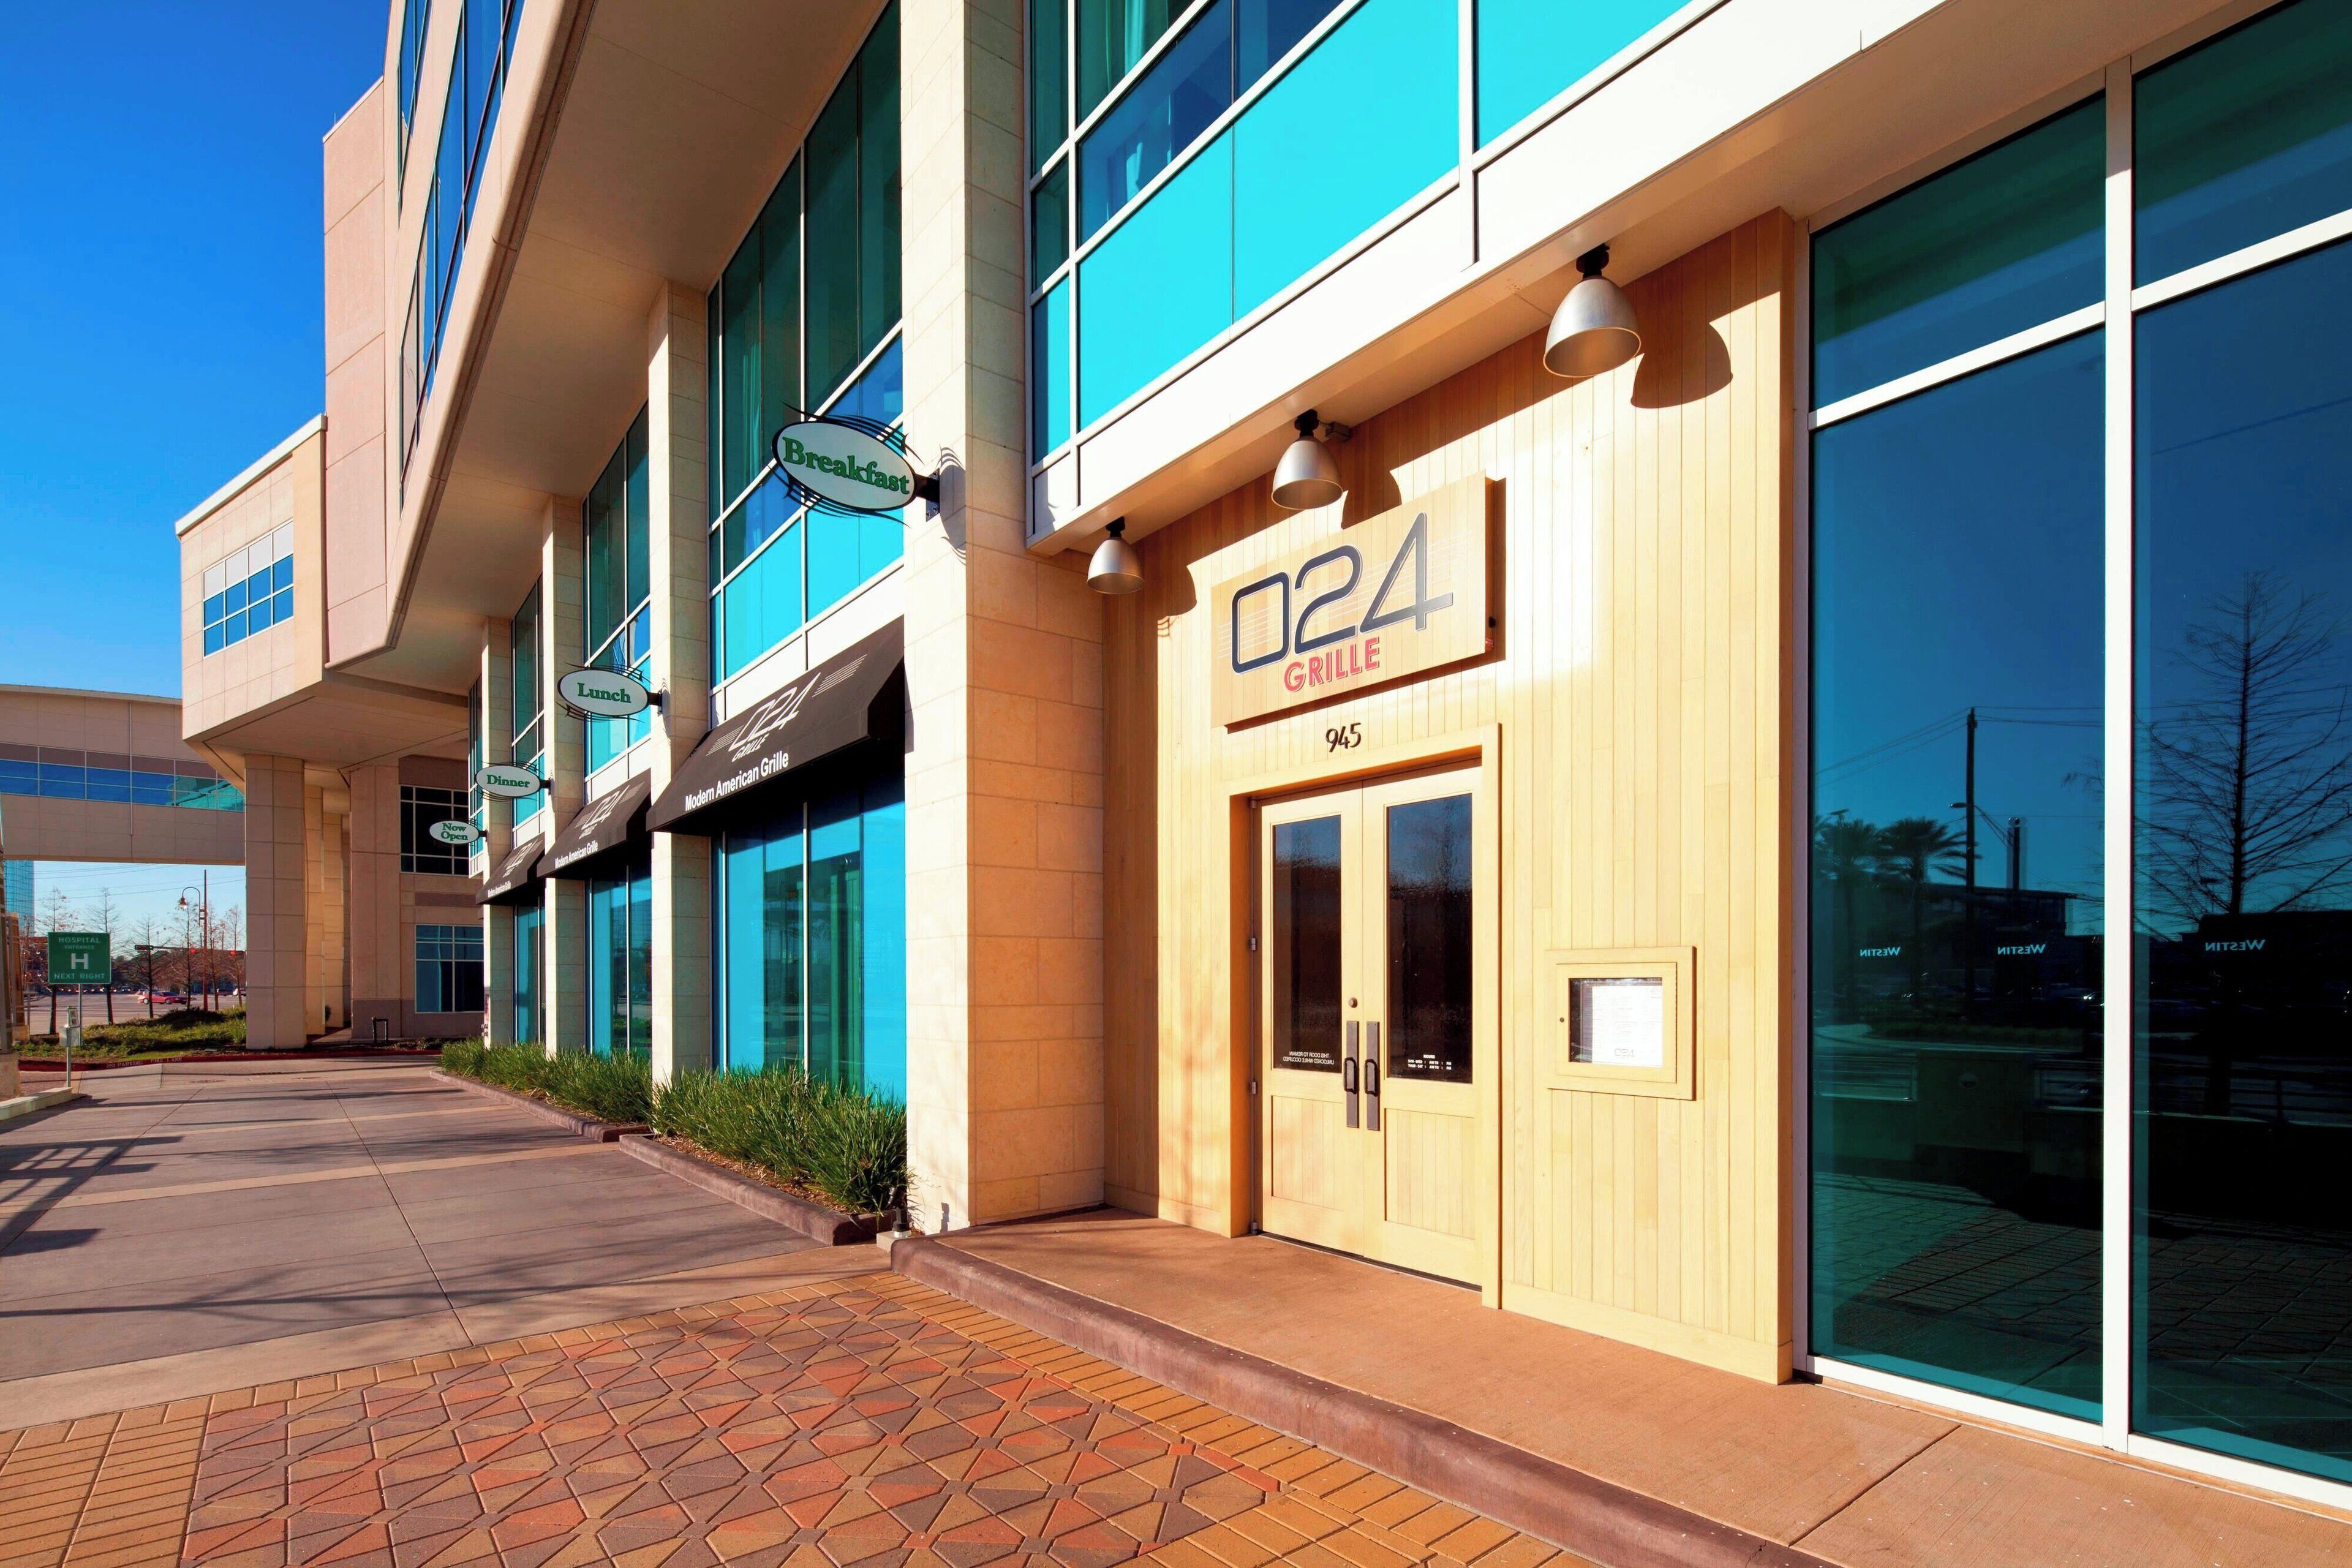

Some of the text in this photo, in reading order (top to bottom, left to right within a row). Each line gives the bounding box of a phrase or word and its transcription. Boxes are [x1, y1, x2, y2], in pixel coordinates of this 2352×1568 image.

[782, 435, 910, 494] Breakfast
[1232, 512, 1453, 674] 024
[1284, 636, 1380, 692] GRILLE
[577, 682, 631, 703] Lunch
[1325, 722, 1361, 753] 945
[486, 774, 530, 788] Dinner
[685, 750, 789, 812] Modern American Grille
[440, 831, 469, 841] Open
[442, 823, 467, 832] Now
[71, 953, 89, 970] H
